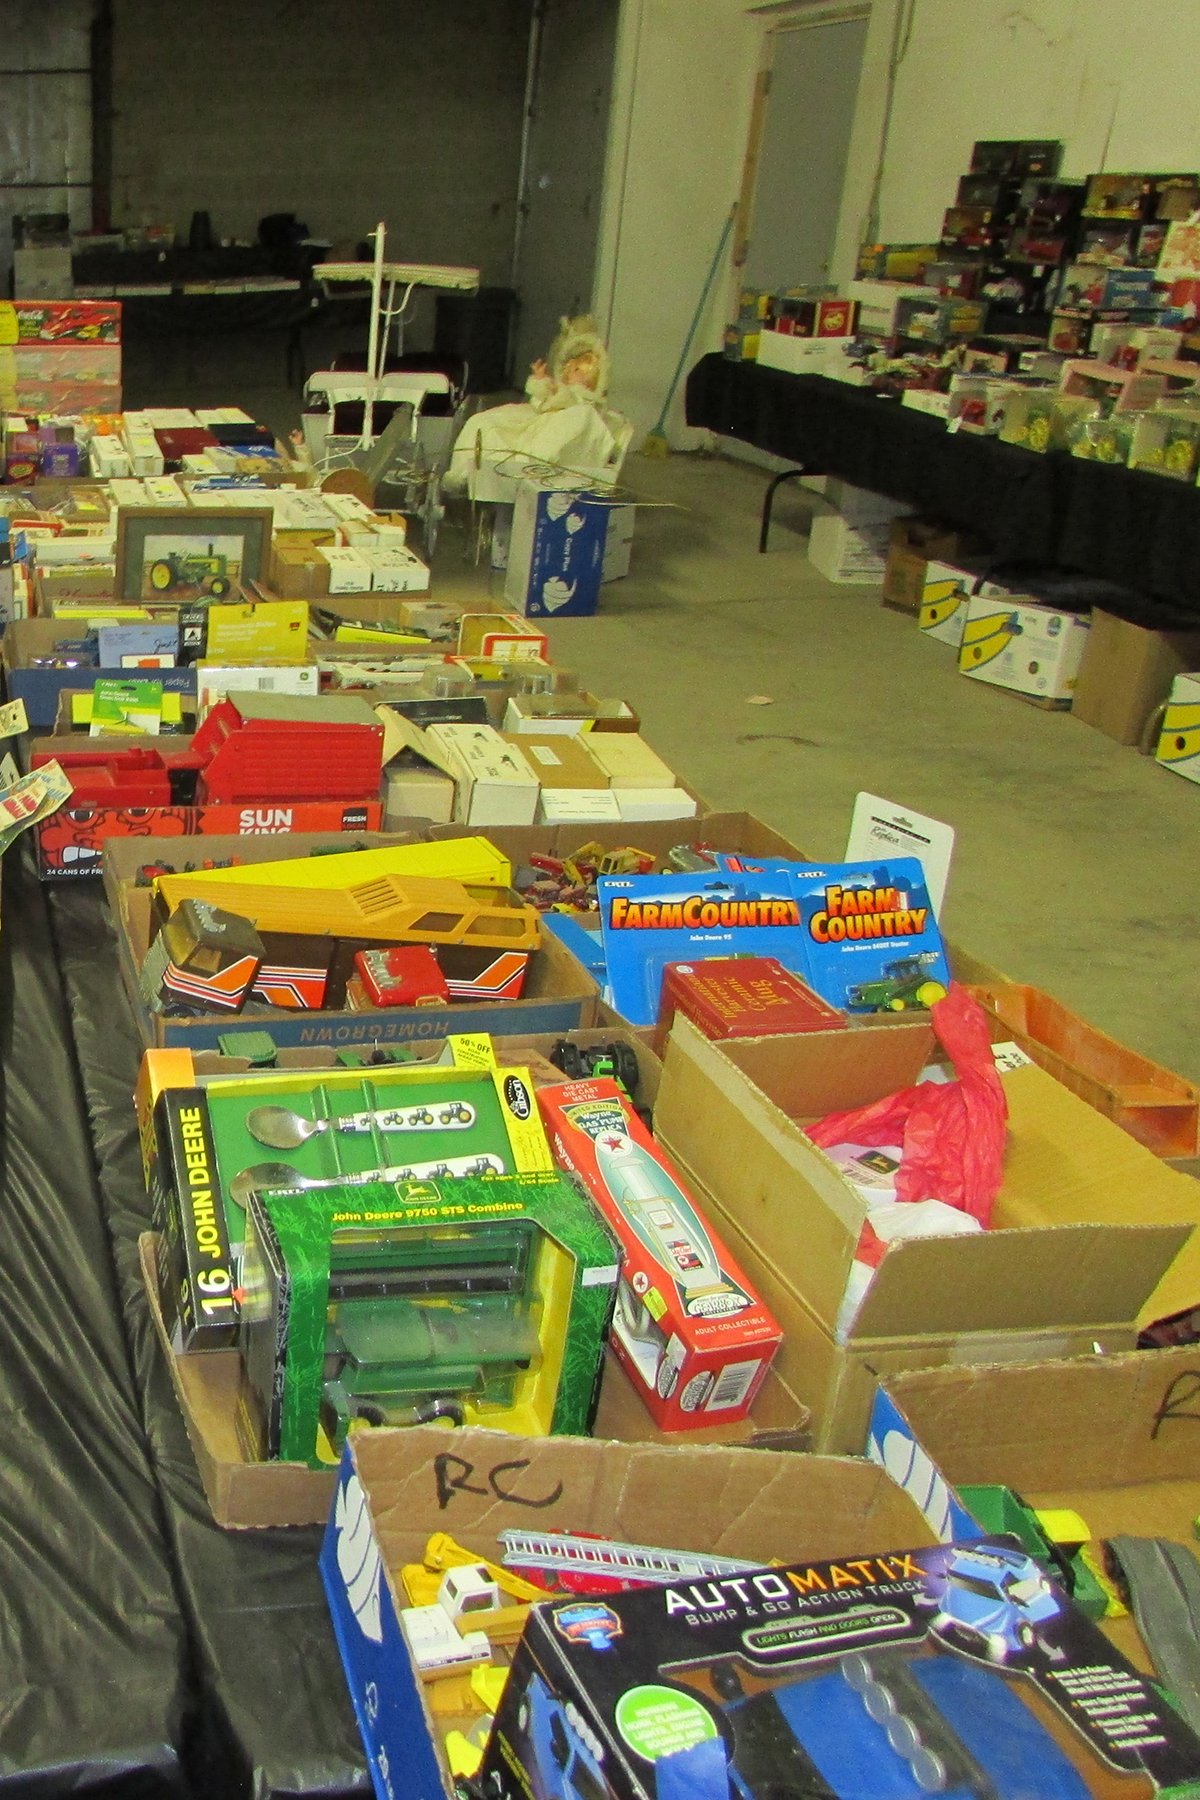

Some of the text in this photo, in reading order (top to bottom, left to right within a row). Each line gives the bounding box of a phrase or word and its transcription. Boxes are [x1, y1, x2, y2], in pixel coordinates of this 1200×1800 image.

[239, 808, 293, 827] SUN
[342, 815, 367, 823] FRESH
[603, 880, 636, 888] ERTL
[796, 871, 826, 879] ERTL
[823, 884, 896, 917] FARM
[808, 907, 928, 944] COUNTRY
[750, 979, 793, 1006] Mug
[300, 1020, 450, 1043] HOMEGROWN
[477, 1042, 491, 1054] OFF
[562, 1086, 599, 1098] DIE CAST
[564, 1082, 590, 1091] HEAVY
[571, 1094, 598, 1102] METAL
[180, 1107, 233, 1316] 16 JOHN DEERE
[332, 1202, 523, 1222] John Deere 9750 STS Combine
[694, 1316, 767, 1336] ADULT COLLECTIBLE
[433, 1452, 563, 1509] RC
[665, 1553, 928, 1615] AUTOMATIX
[685, 1580, 928, 1626] BUMP & GO ACTION TRUCK
[757, 1633, 788, 1645] LIGHTS
[789, 1628, 818, 1641] FLASH
[819, 1624, 836, 1634] AND
[838, 1618, 870, 1631] DOORS
